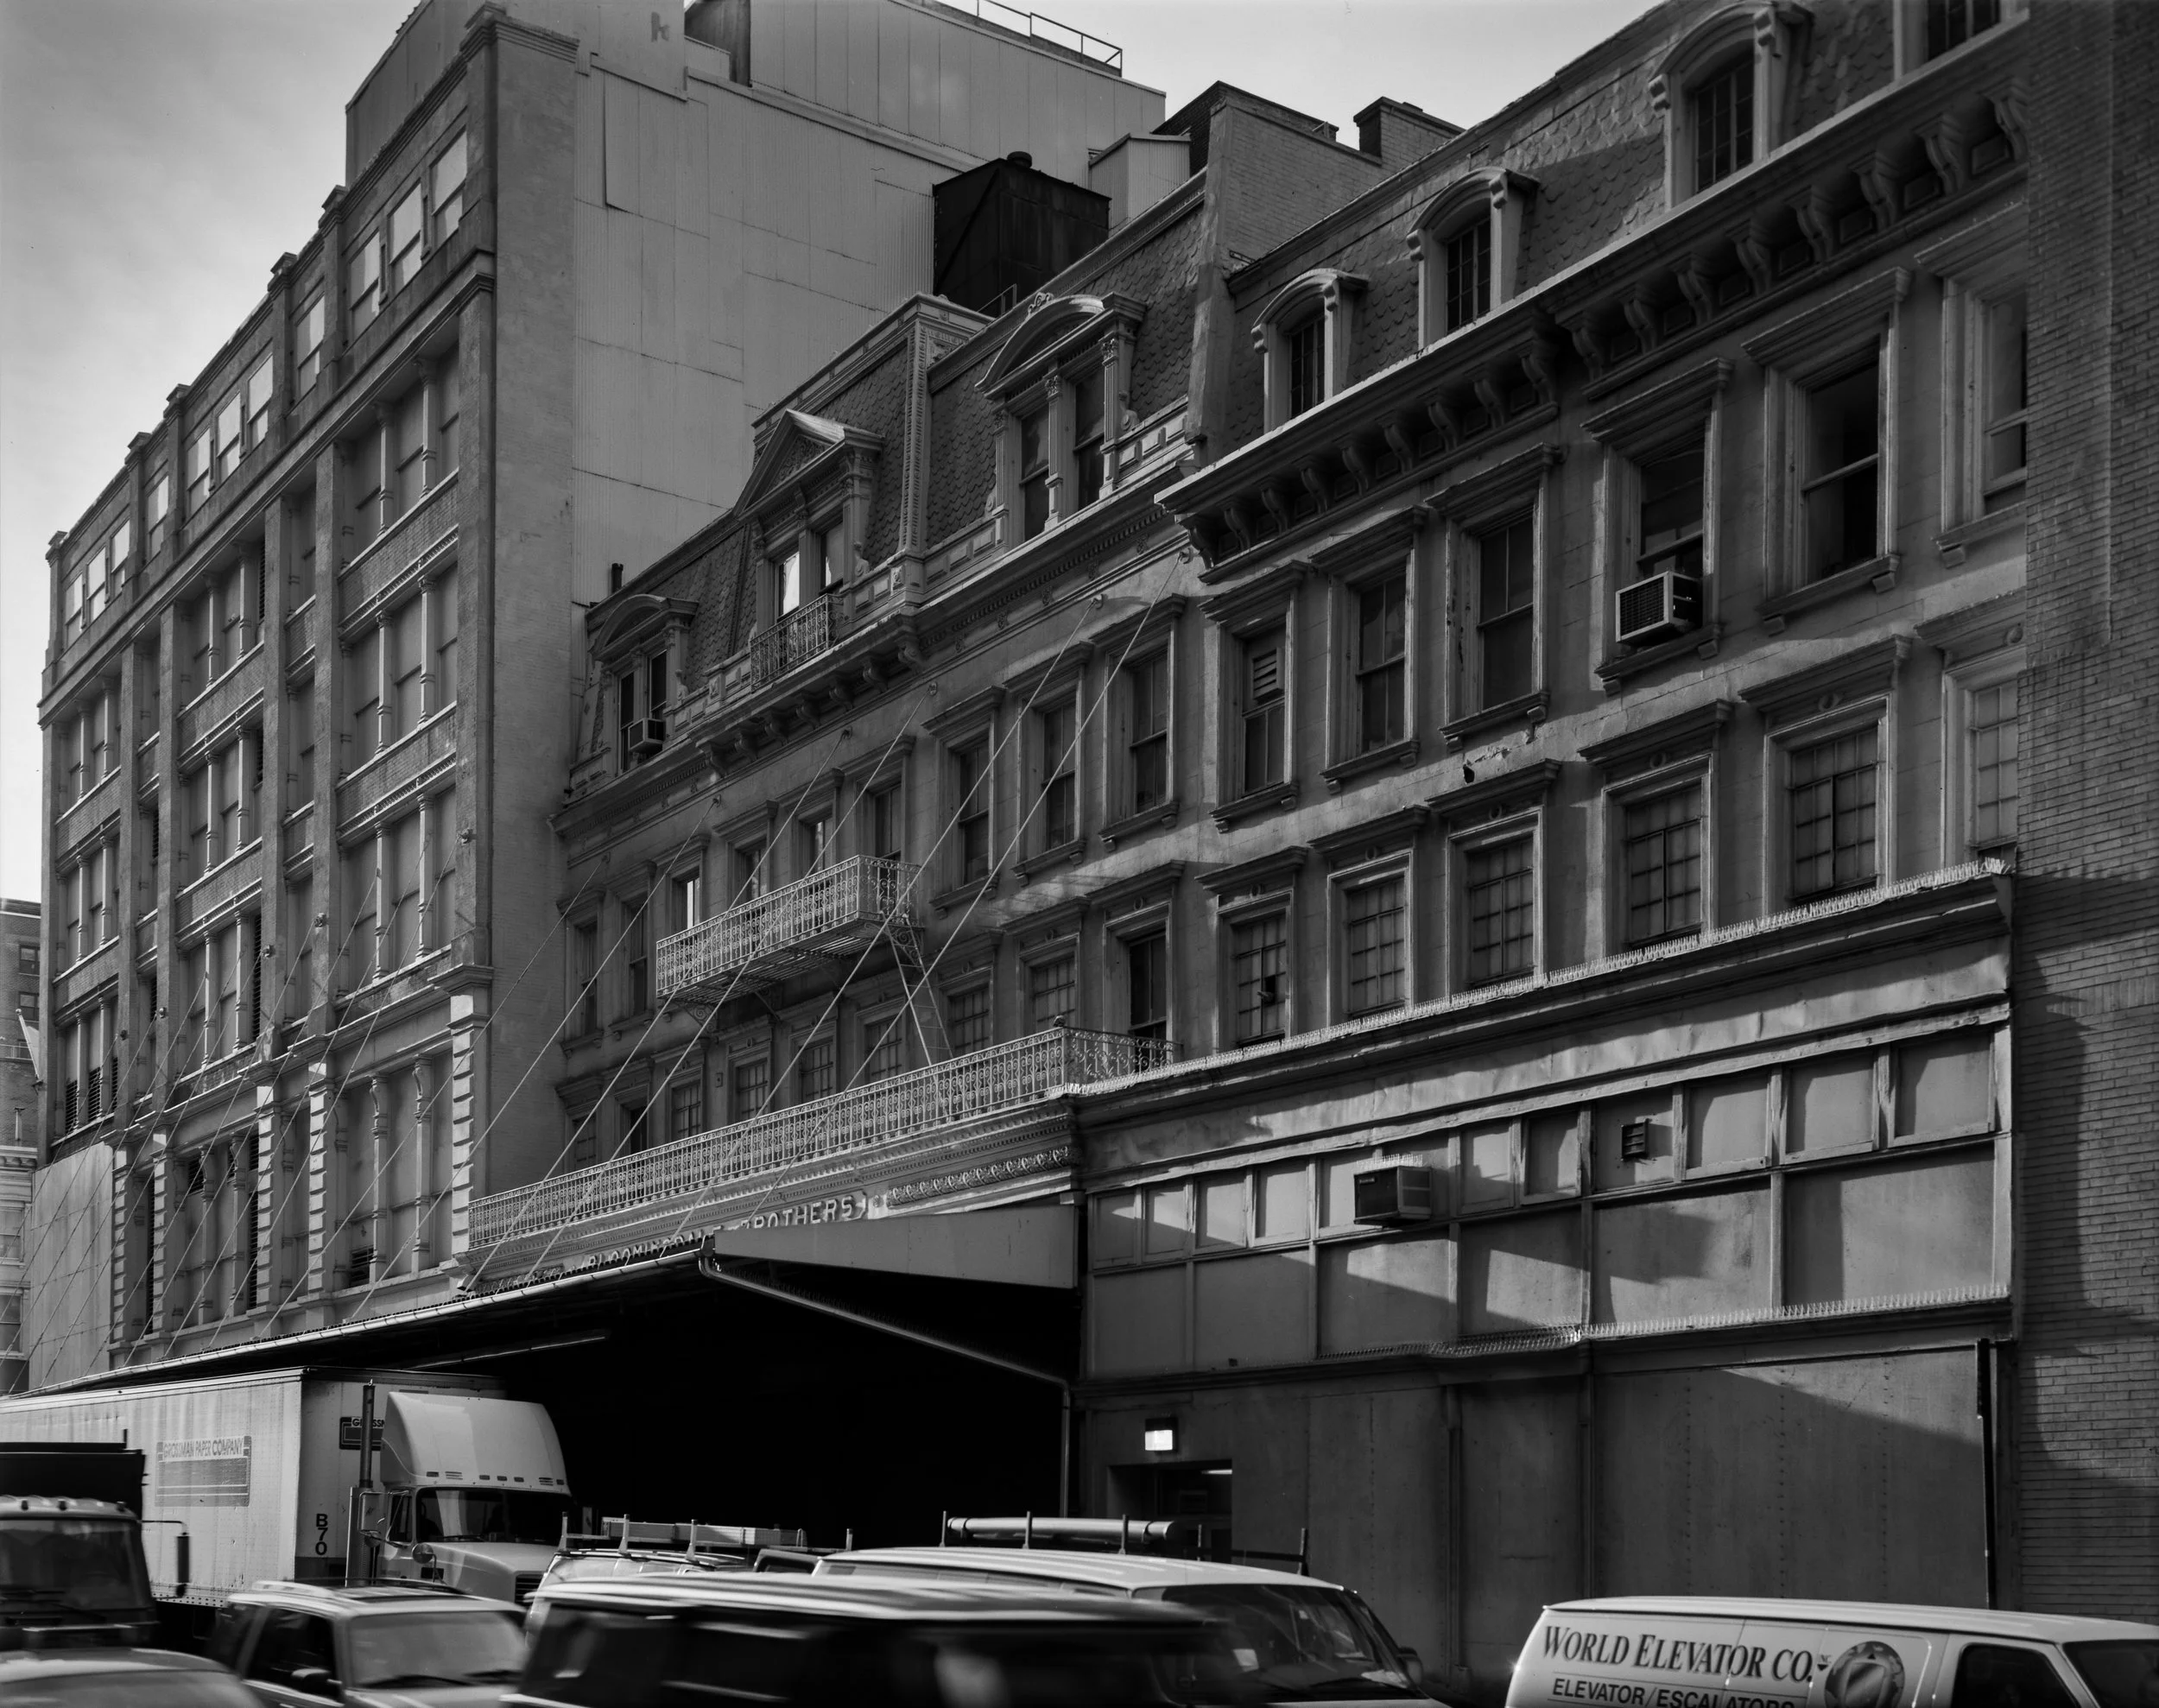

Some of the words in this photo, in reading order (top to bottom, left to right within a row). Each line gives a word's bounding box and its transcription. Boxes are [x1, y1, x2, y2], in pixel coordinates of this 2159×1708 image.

[195, 1439, 212, 1457] PAPER
[212, 1437, 243, 1456] COMPANY
[1543, 1626, 1630, 1666] WORLD
[1633, 1634, 1767, 1679] ELEVATOR
[1772, 1648, 1813, 1683] CO.
